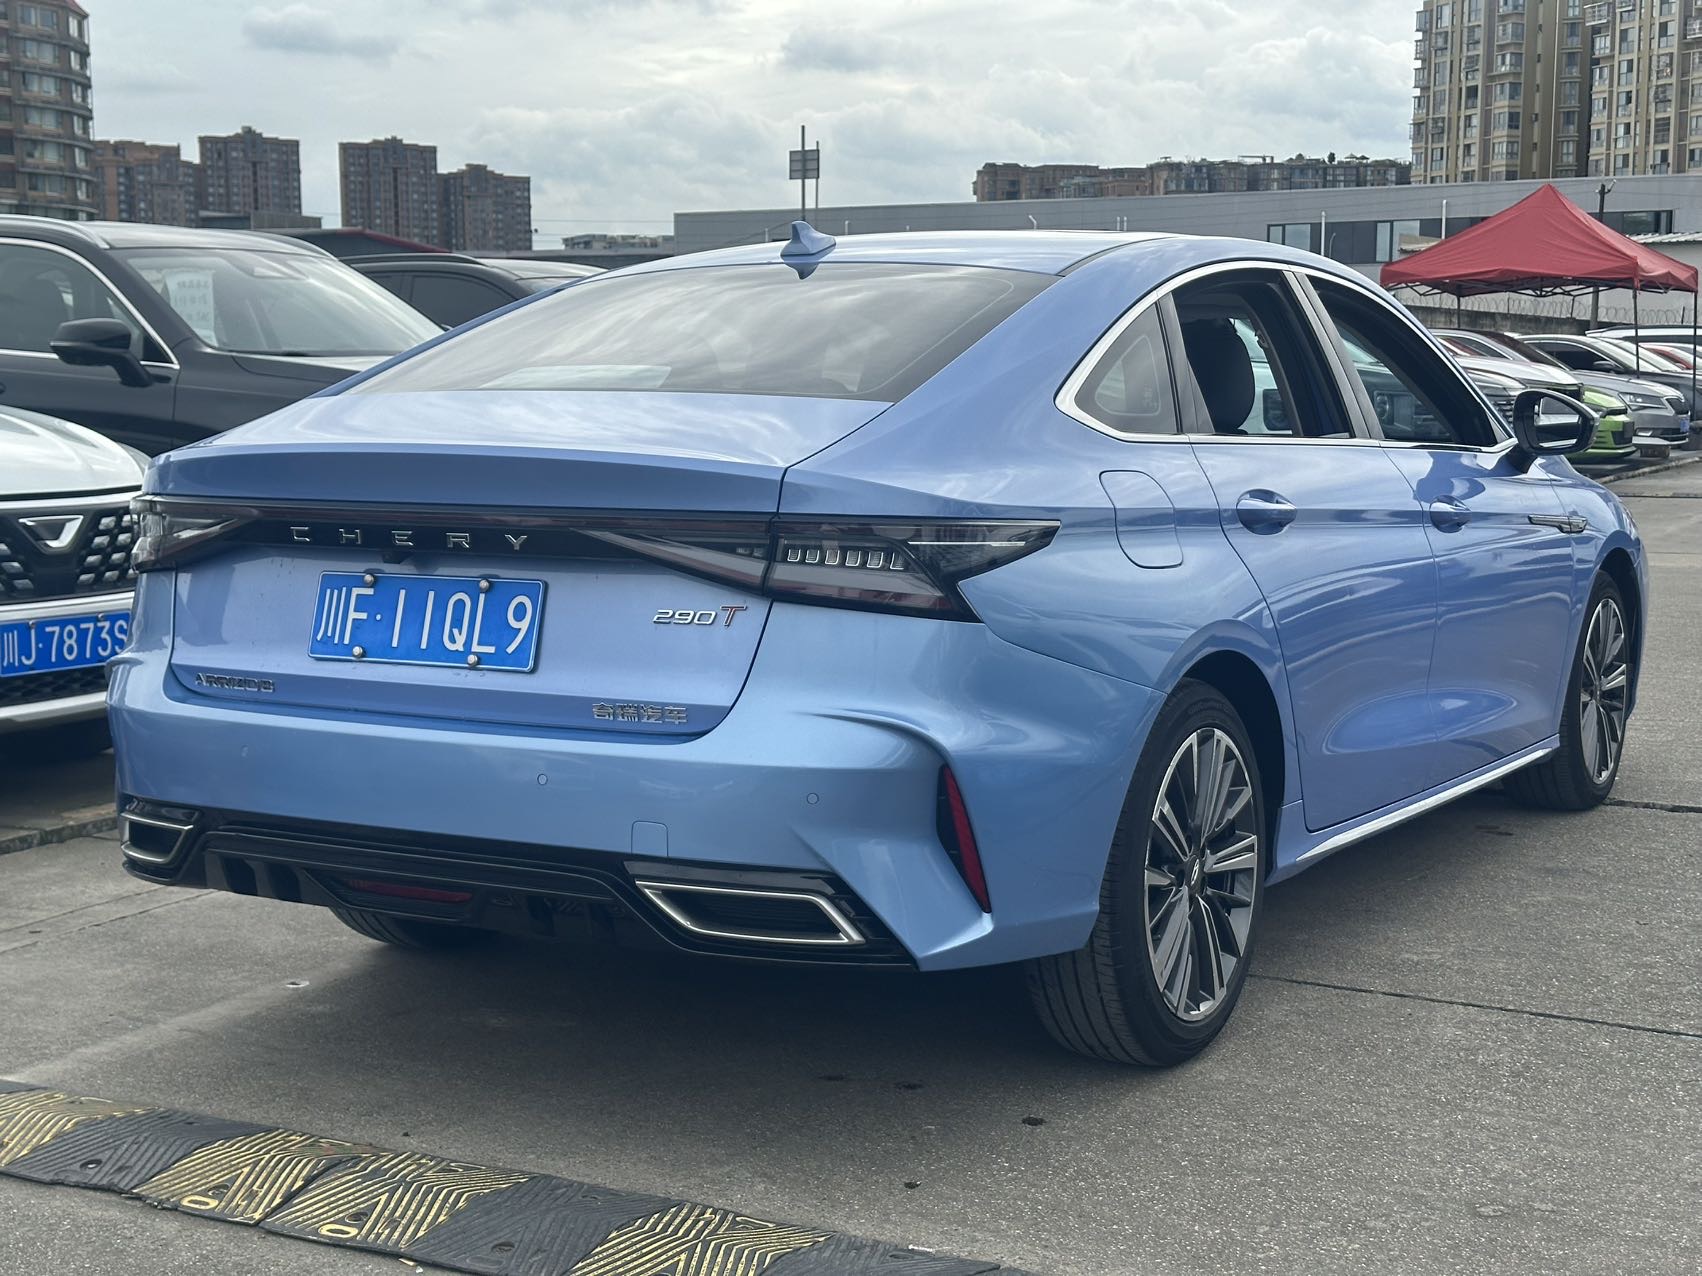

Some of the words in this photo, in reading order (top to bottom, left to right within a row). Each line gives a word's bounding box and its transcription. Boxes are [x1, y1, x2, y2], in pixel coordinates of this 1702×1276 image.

[290, 525, 528, 550] CHERY
[592, 701, 688, 725] 奇瑞汽车
